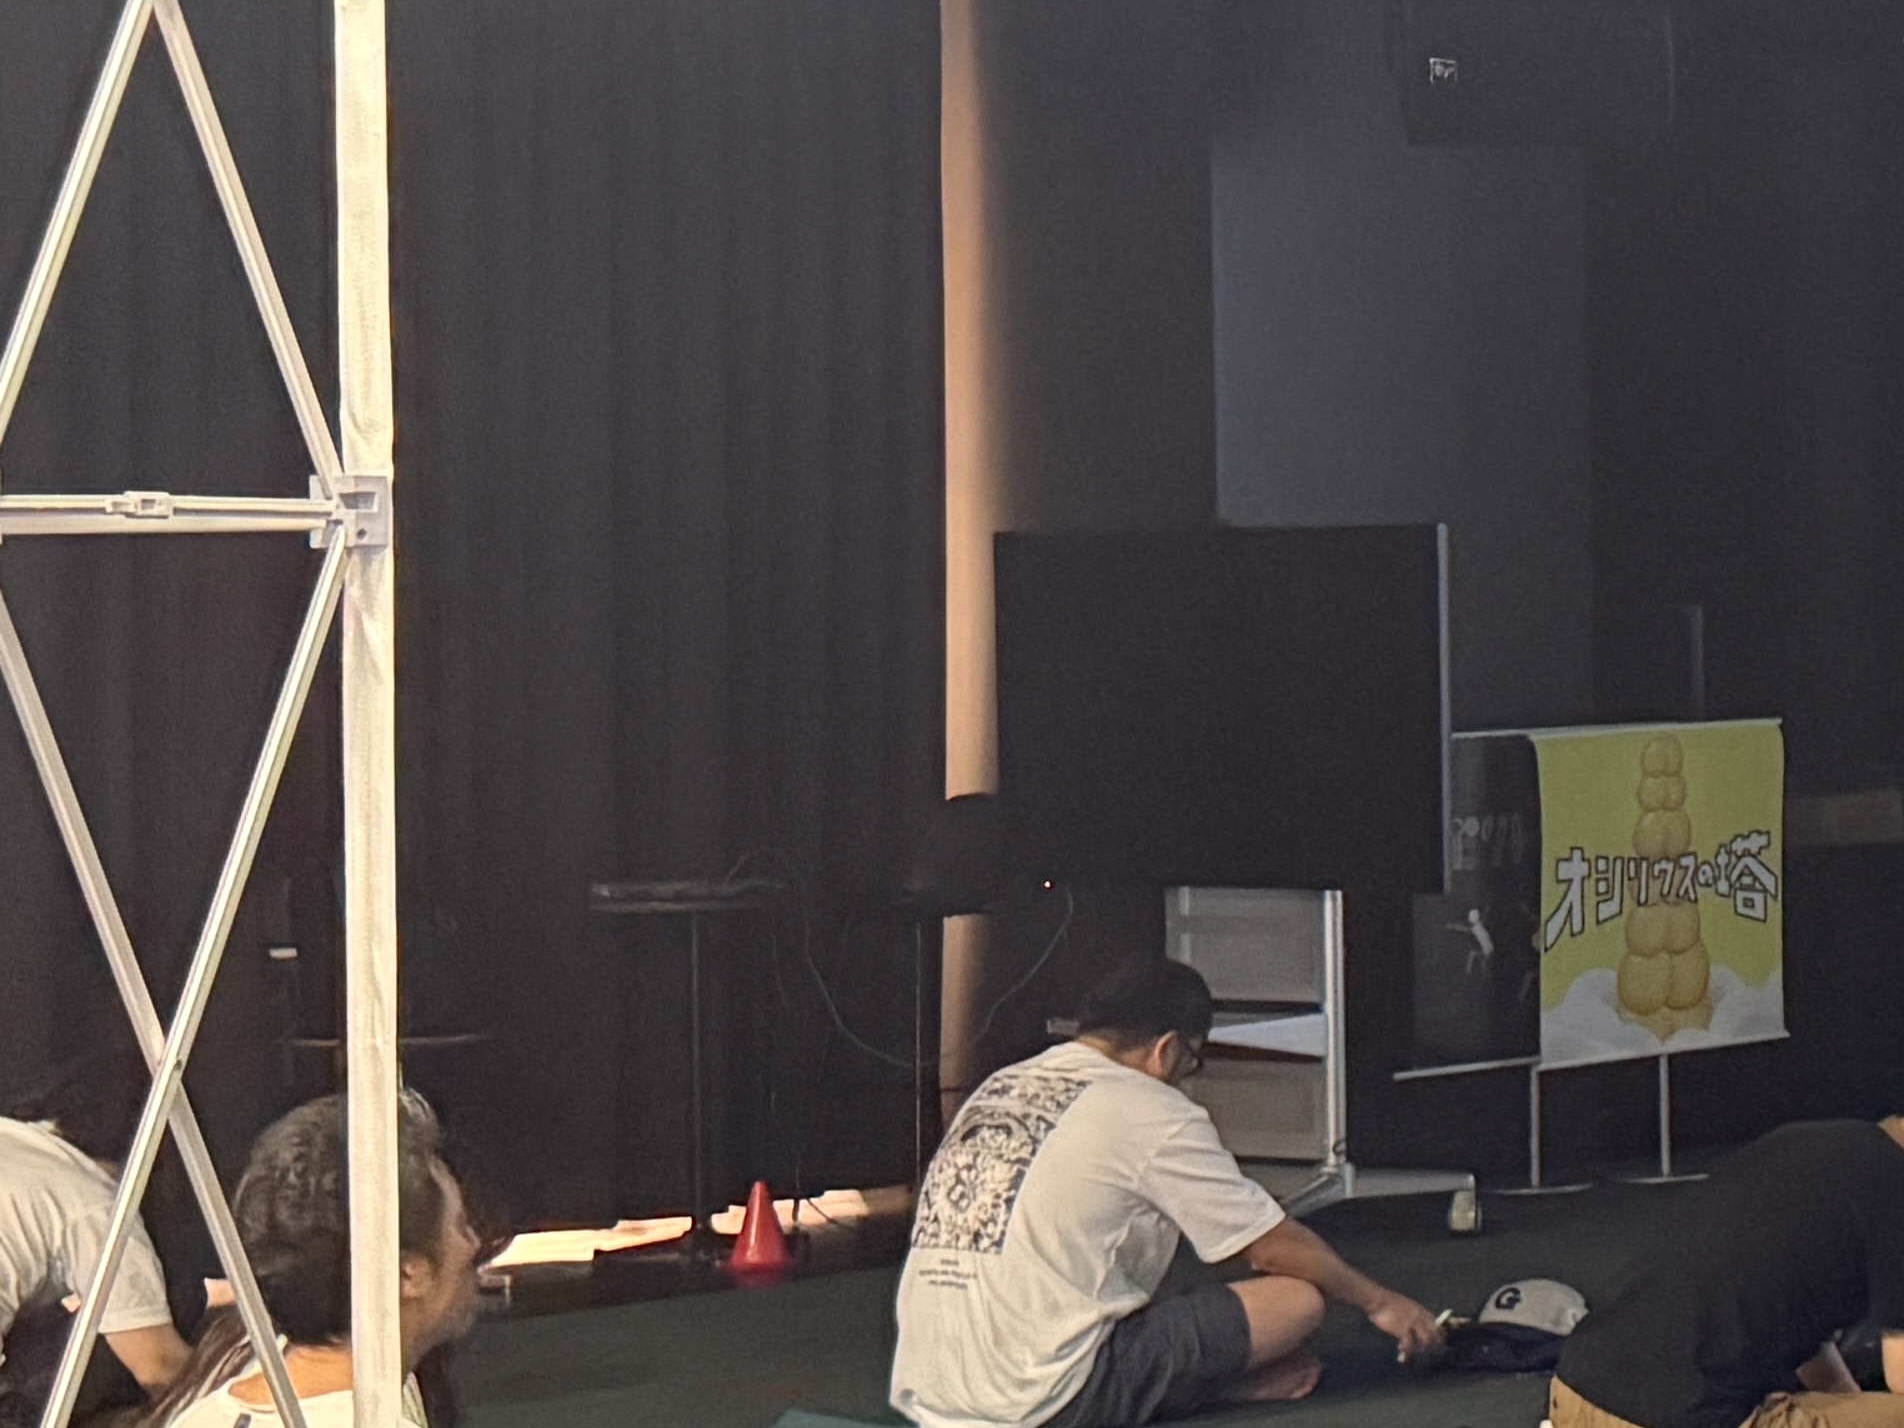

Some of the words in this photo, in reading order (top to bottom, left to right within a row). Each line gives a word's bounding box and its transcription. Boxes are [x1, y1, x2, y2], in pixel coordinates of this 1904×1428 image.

[1543, 829, 1780, 953] オシリウスの塔
